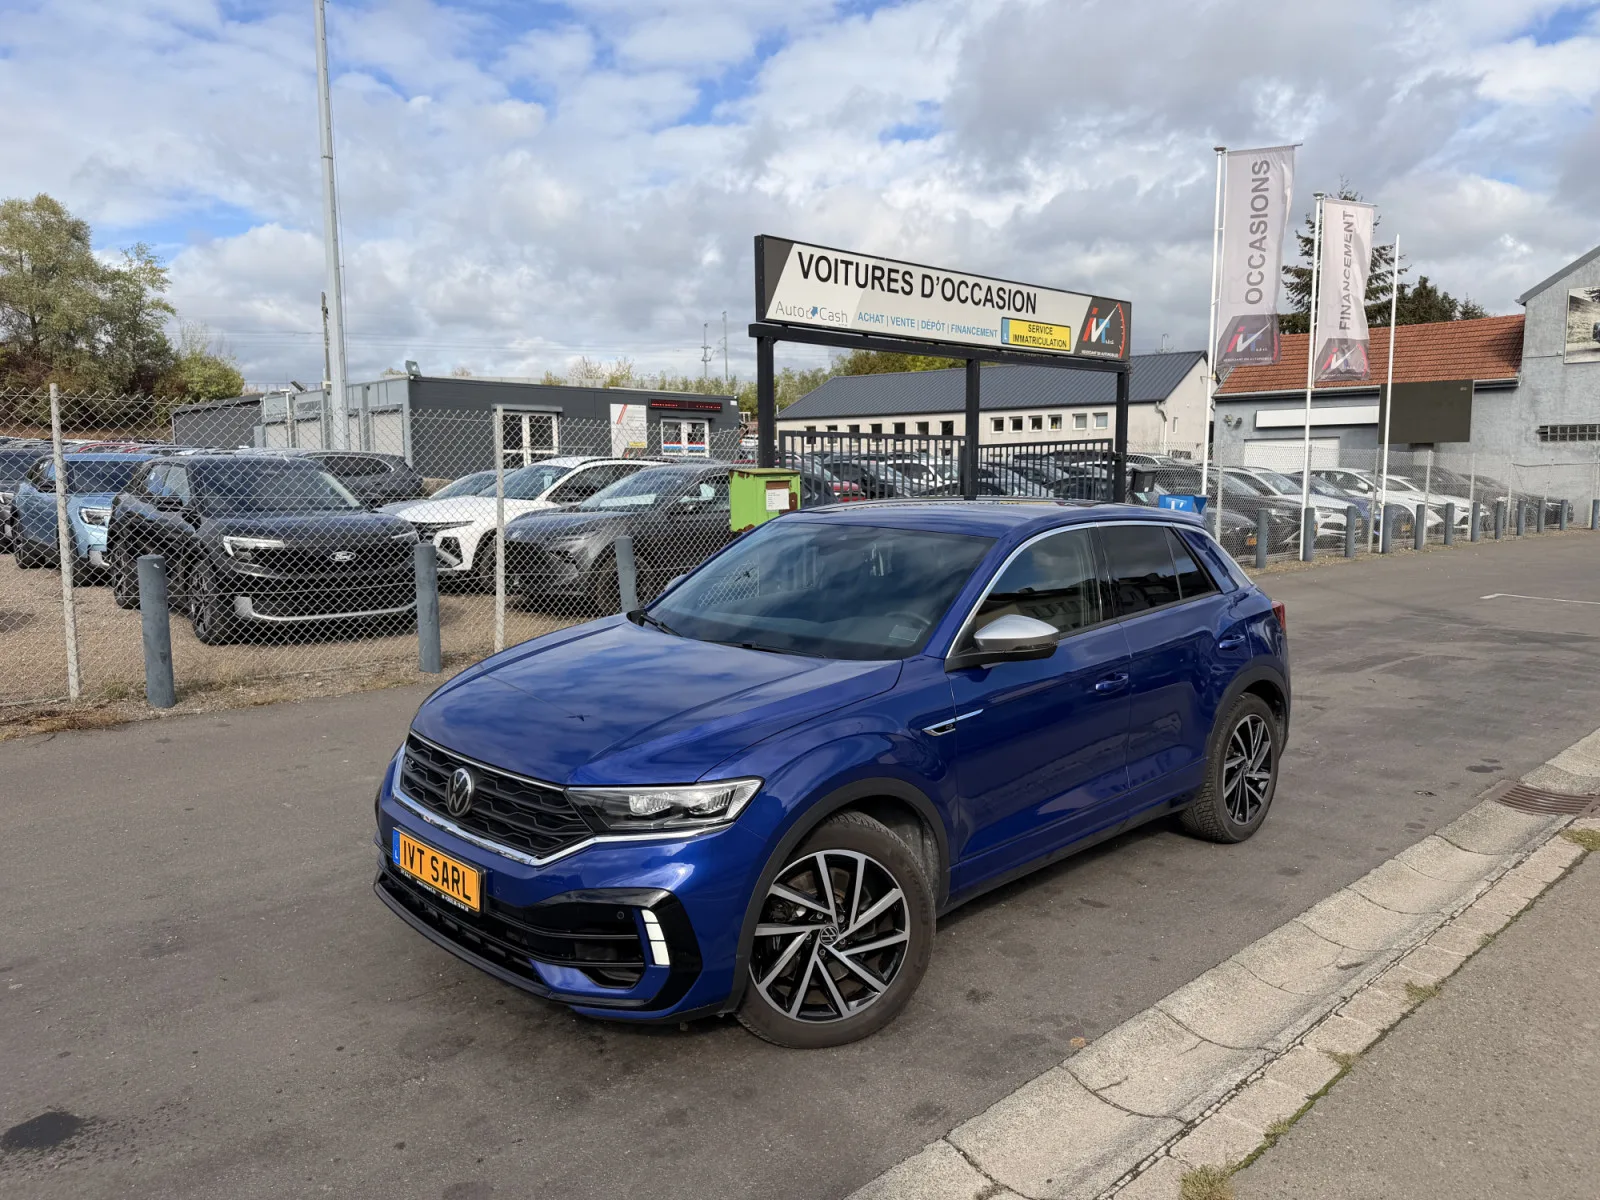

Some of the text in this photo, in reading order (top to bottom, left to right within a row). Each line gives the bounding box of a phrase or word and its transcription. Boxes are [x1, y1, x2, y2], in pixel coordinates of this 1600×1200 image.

[1244, 159, 1271, 305] OCCASIONS
[797, 251, 1037, 315] VOITURES D'OCCASION
[1339, 210, 1355, 332] FINANCEMENT
[775, 300, 848, 323] Auto Cash
[858, 311, 885, 326] ACHAT
[891, 316, 915, 328] VENTE
[951, 323, 998, 338] FINANCEMENT
[1027, 324, 1053, 336] SERVICE
[1012, 333, 1067, 348] IMMATRICULATION
[403, 839, 425, 875] IVT
[430, 855, 472, 902] SARL
